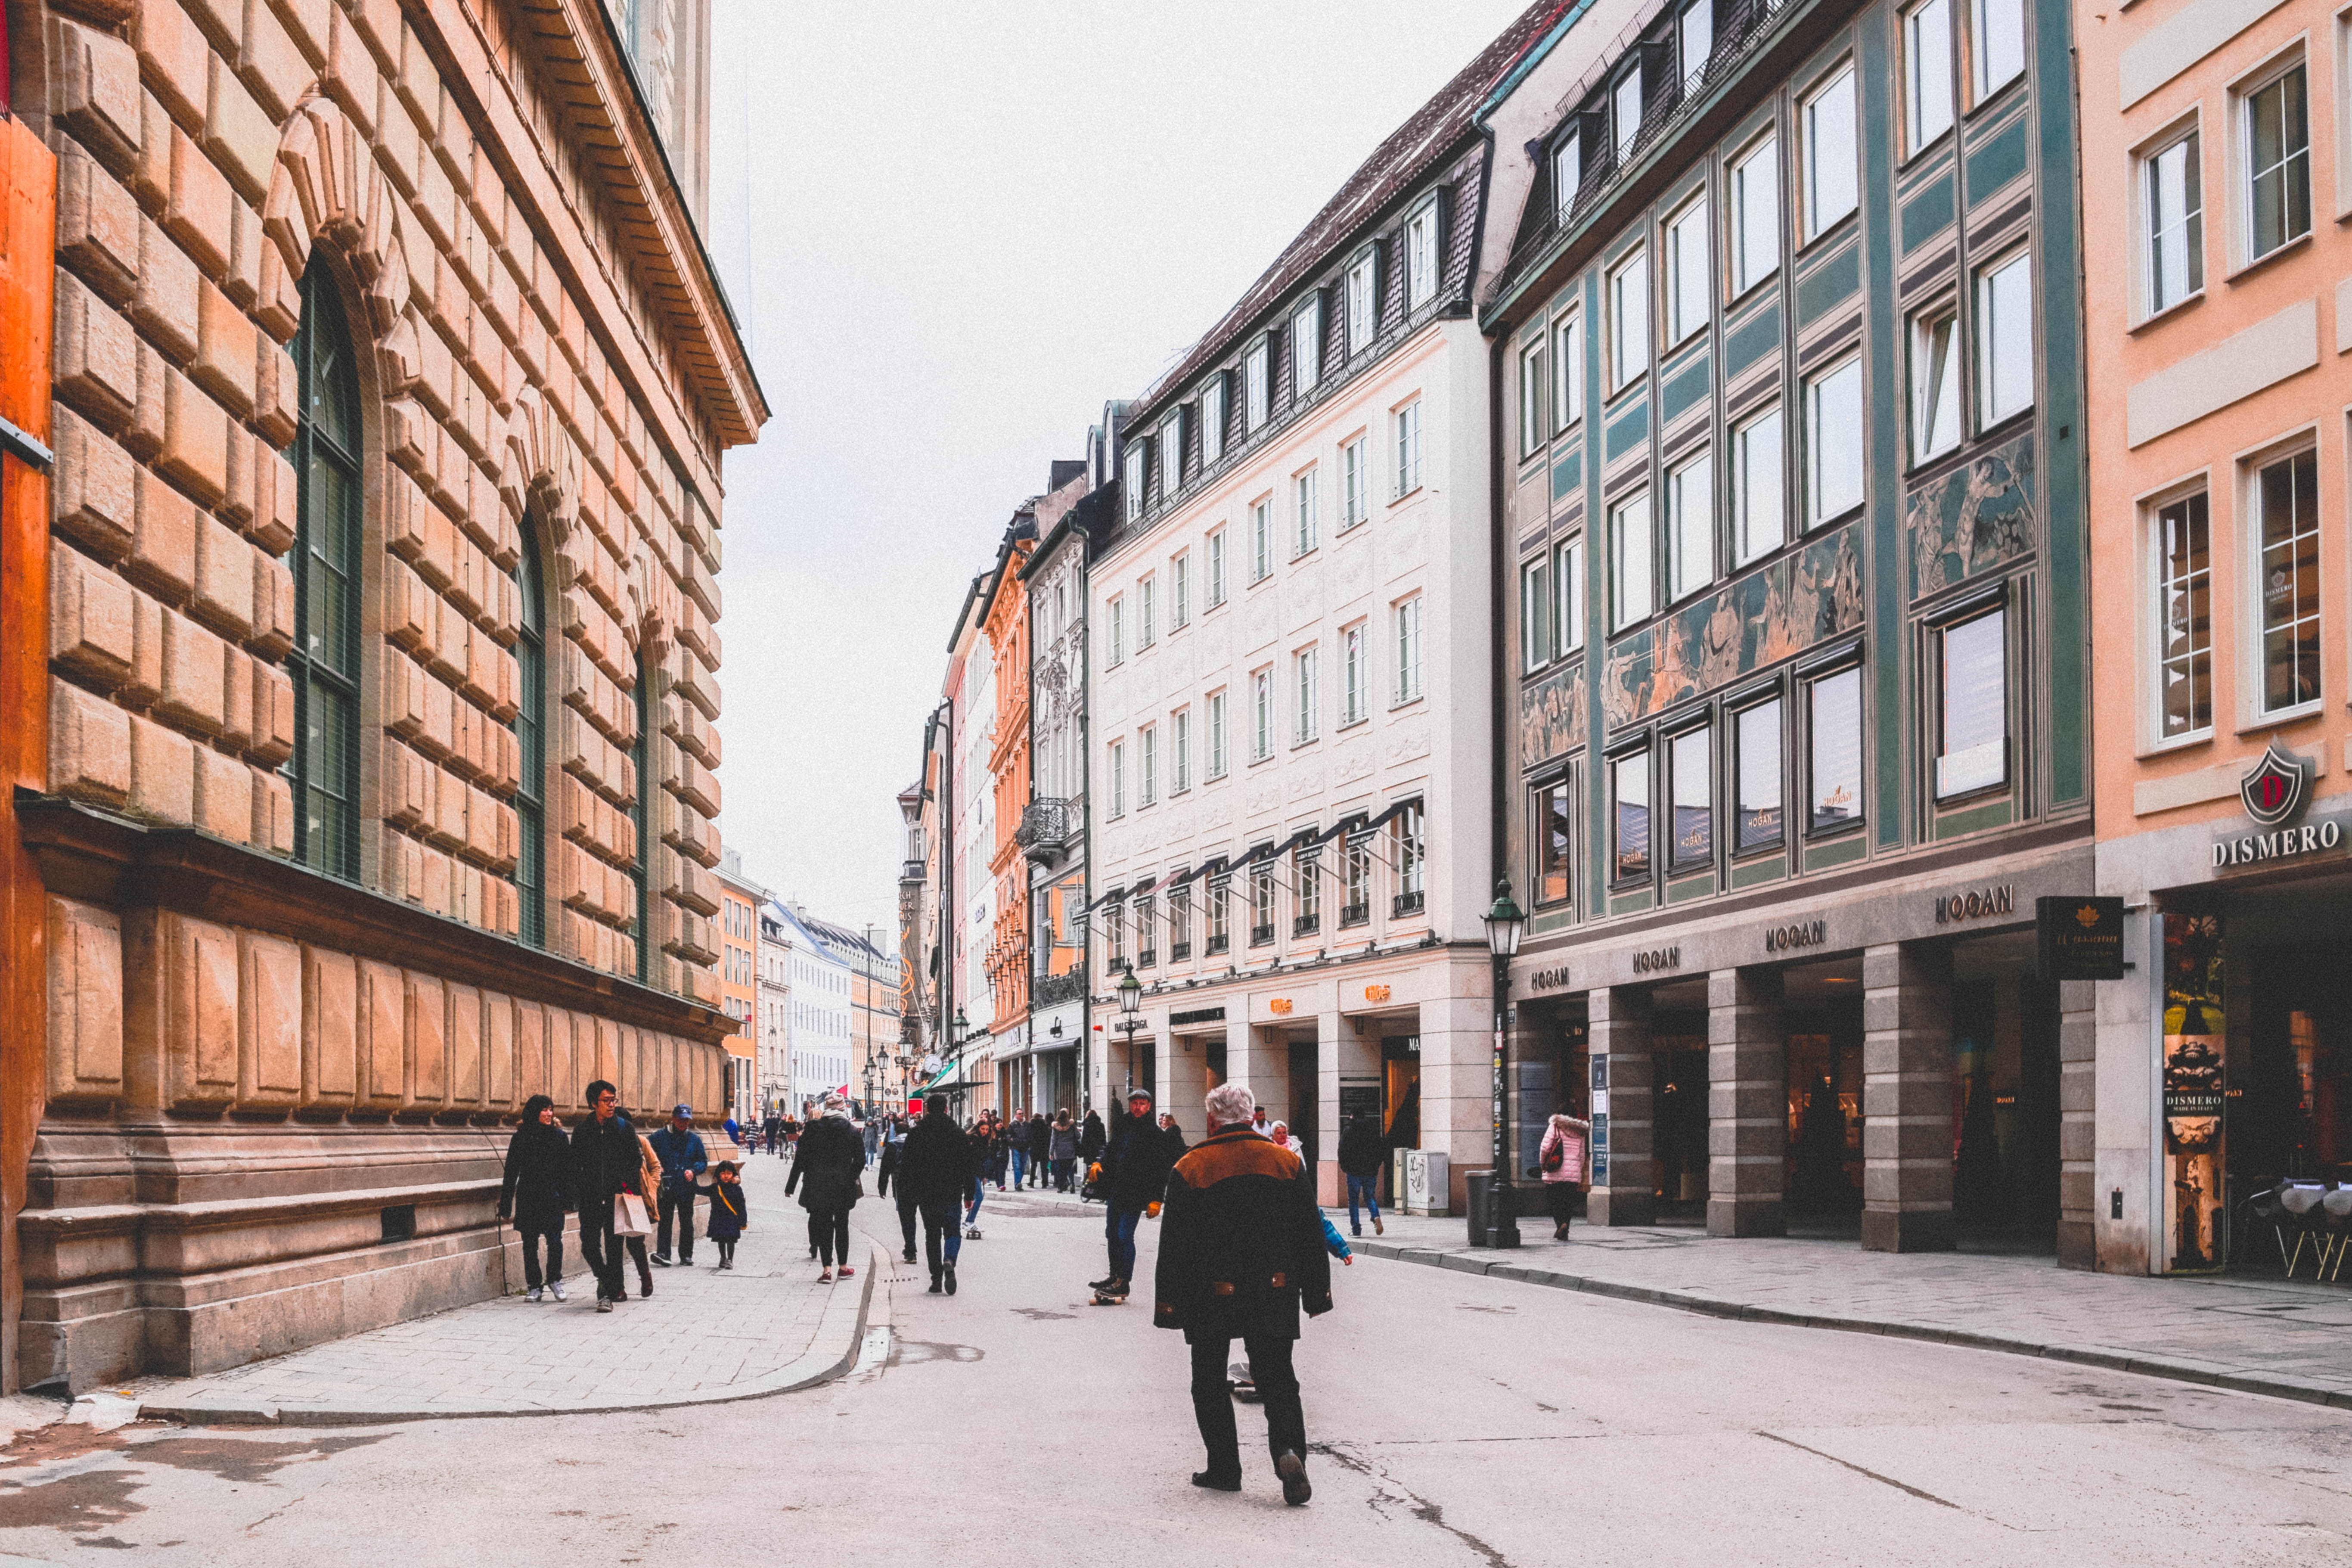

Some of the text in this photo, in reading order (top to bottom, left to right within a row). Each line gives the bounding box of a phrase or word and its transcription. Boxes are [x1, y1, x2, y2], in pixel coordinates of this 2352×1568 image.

[1824, 791, 1851, 807] HOGAN
[2262, 776, 2282, 807] D
[1748, 813, 1772, 829] HOGAN
[1681, 834, 1702, 848] HOGAN
[2212, 821, 2339, 867] DISMERO
[1623, 851, 1642, 865] HOGAN
[1936, 884, 2013, 923] HOGAN
[1766, 919, 1825, 952] HOGAN
[1633, 947, 1679, 973] HOGAN
[1531, 967, 1569, 990] HOGAN
[2167, 1096, 2221, 1105] DISMERO
